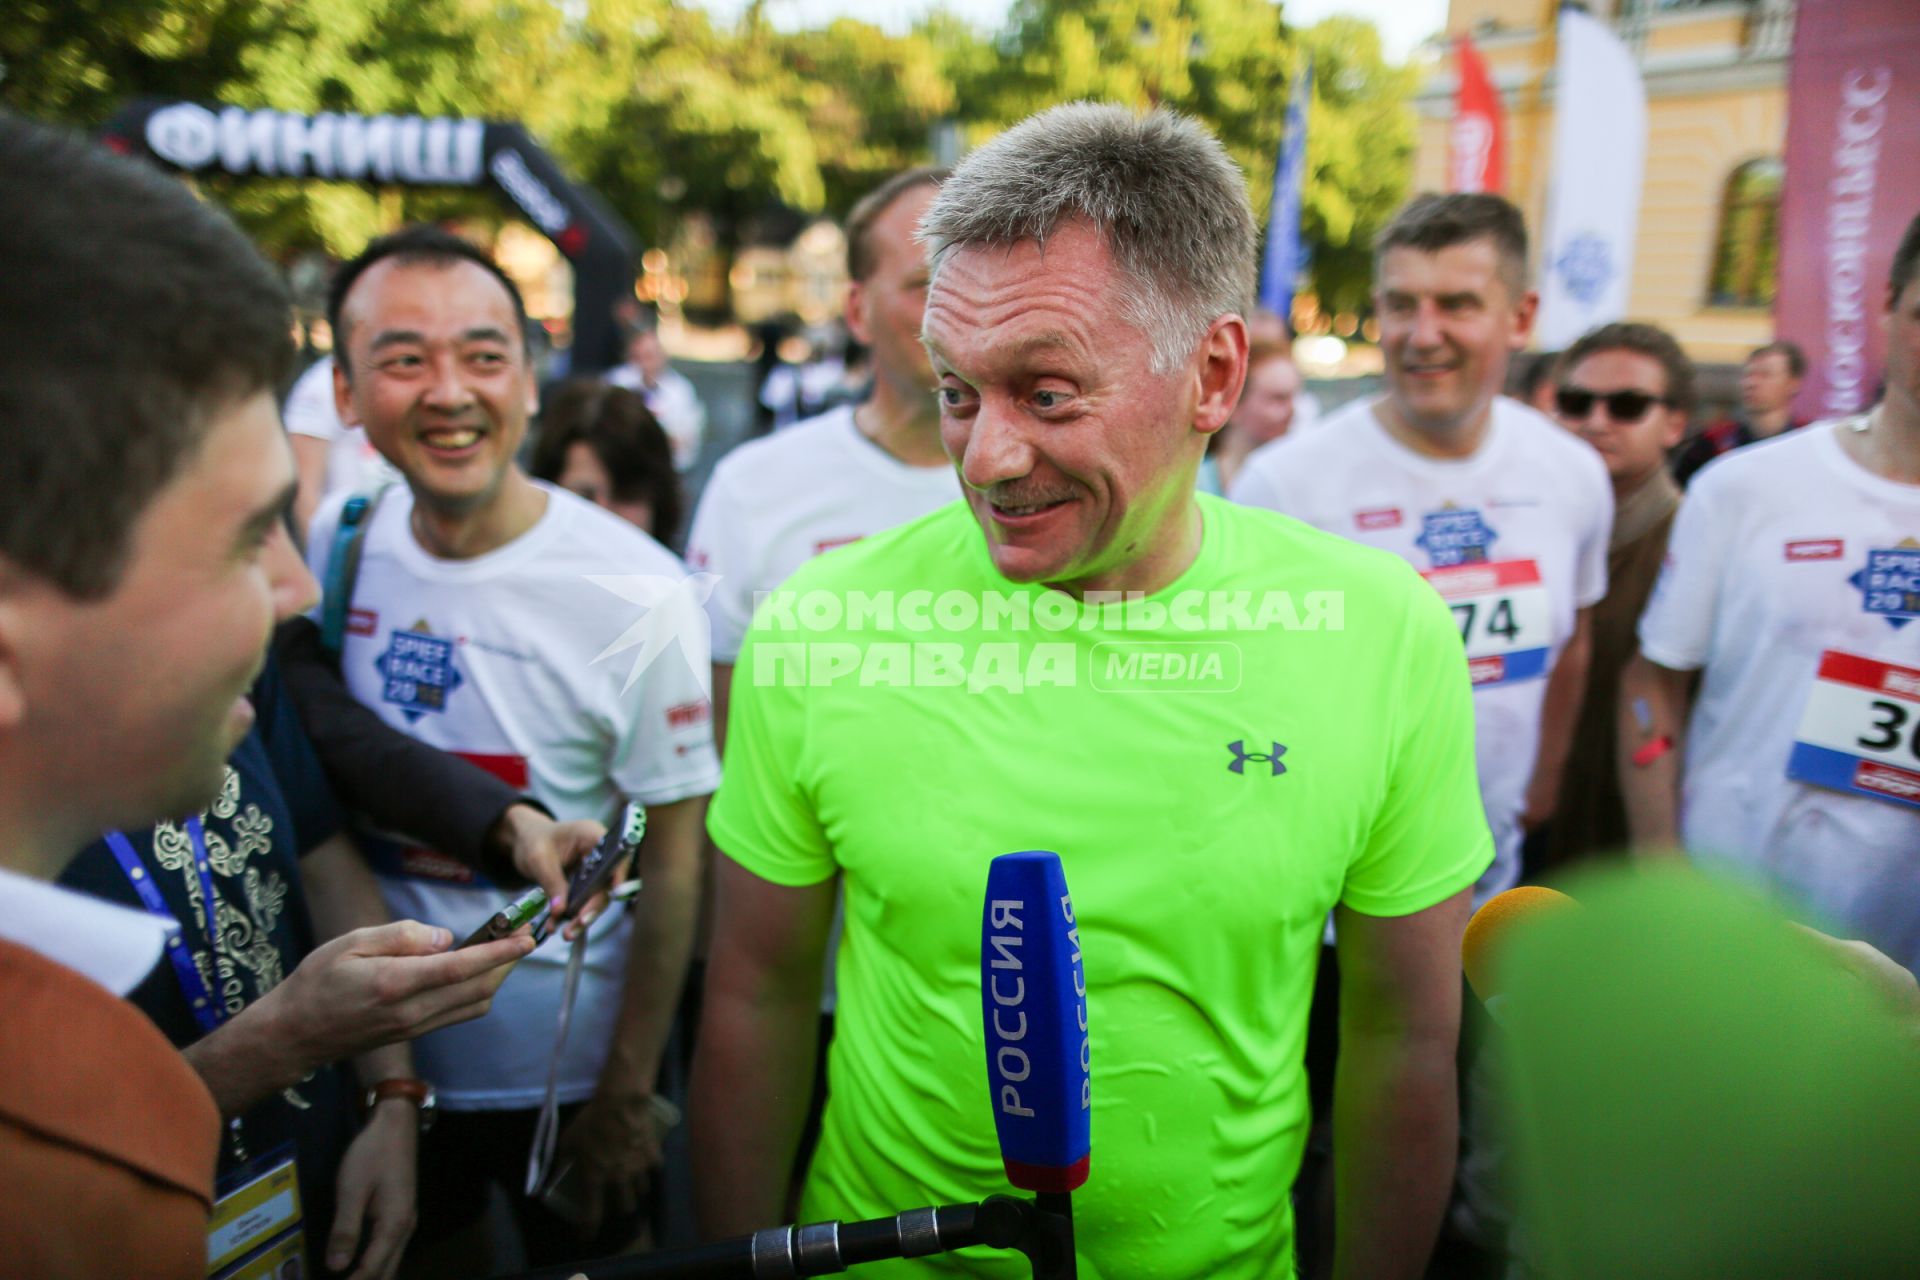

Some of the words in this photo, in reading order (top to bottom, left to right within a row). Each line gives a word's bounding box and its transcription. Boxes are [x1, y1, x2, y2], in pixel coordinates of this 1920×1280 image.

[145, 102, 486, 183] ФИНИШ
[1449, 599, 1520, 645] 74
[1857, 700, 1920, 762] 3
[991, 899, 1034, 1117] РОССИЯ
